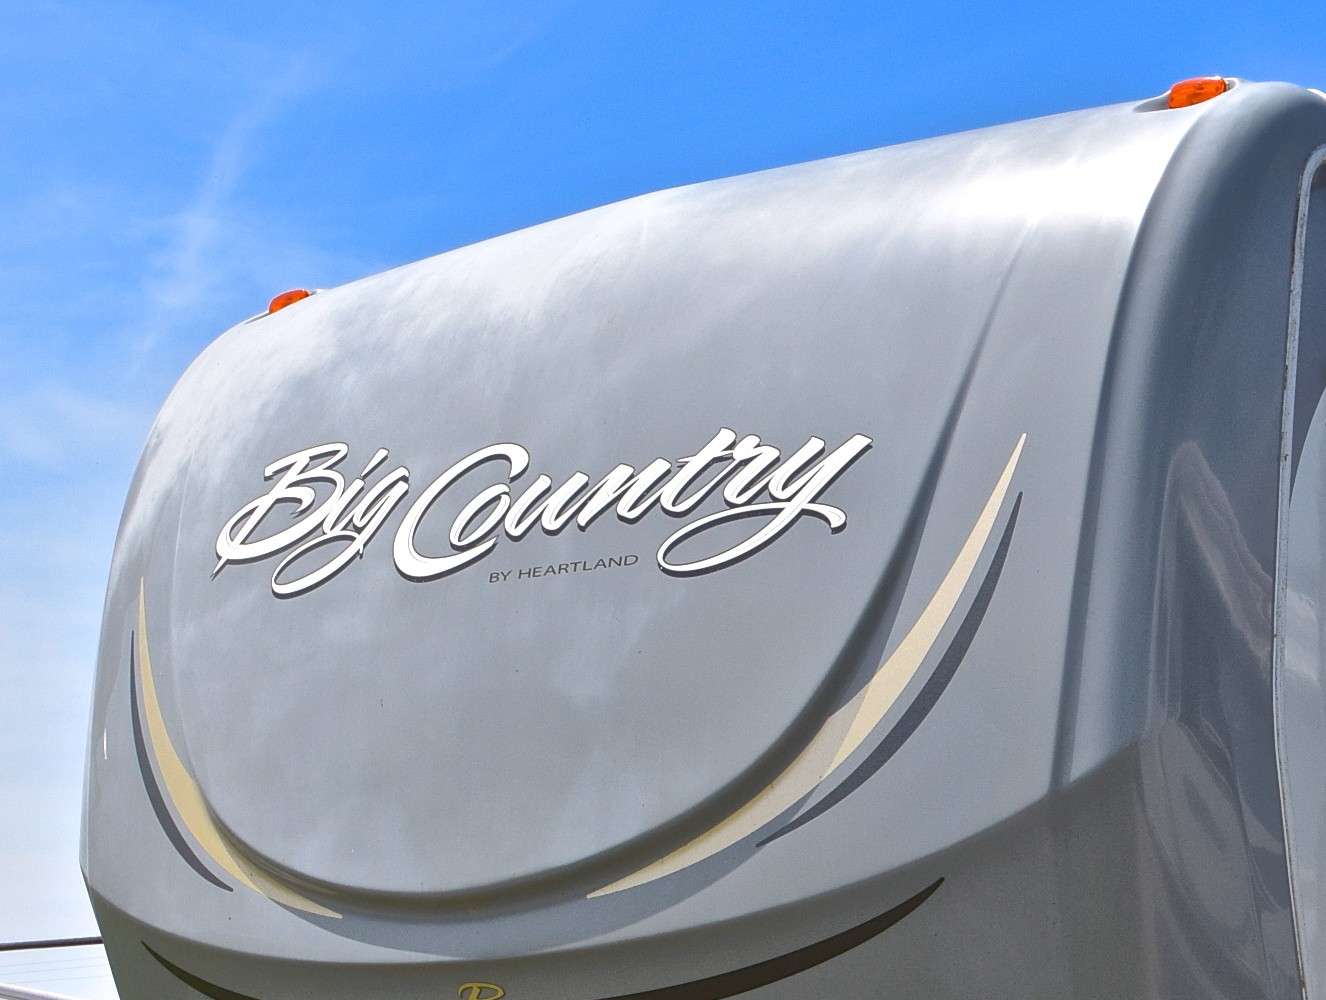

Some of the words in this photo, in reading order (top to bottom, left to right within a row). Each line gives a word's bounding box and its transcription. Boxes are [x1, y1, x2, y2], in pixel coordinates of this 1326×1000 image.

[210, 441, 411, 600] Big
[393, 427, 874, 583] Country
[489, 570, 512, 583] BY
[518, 554, 639, 580] HEARTLAND
